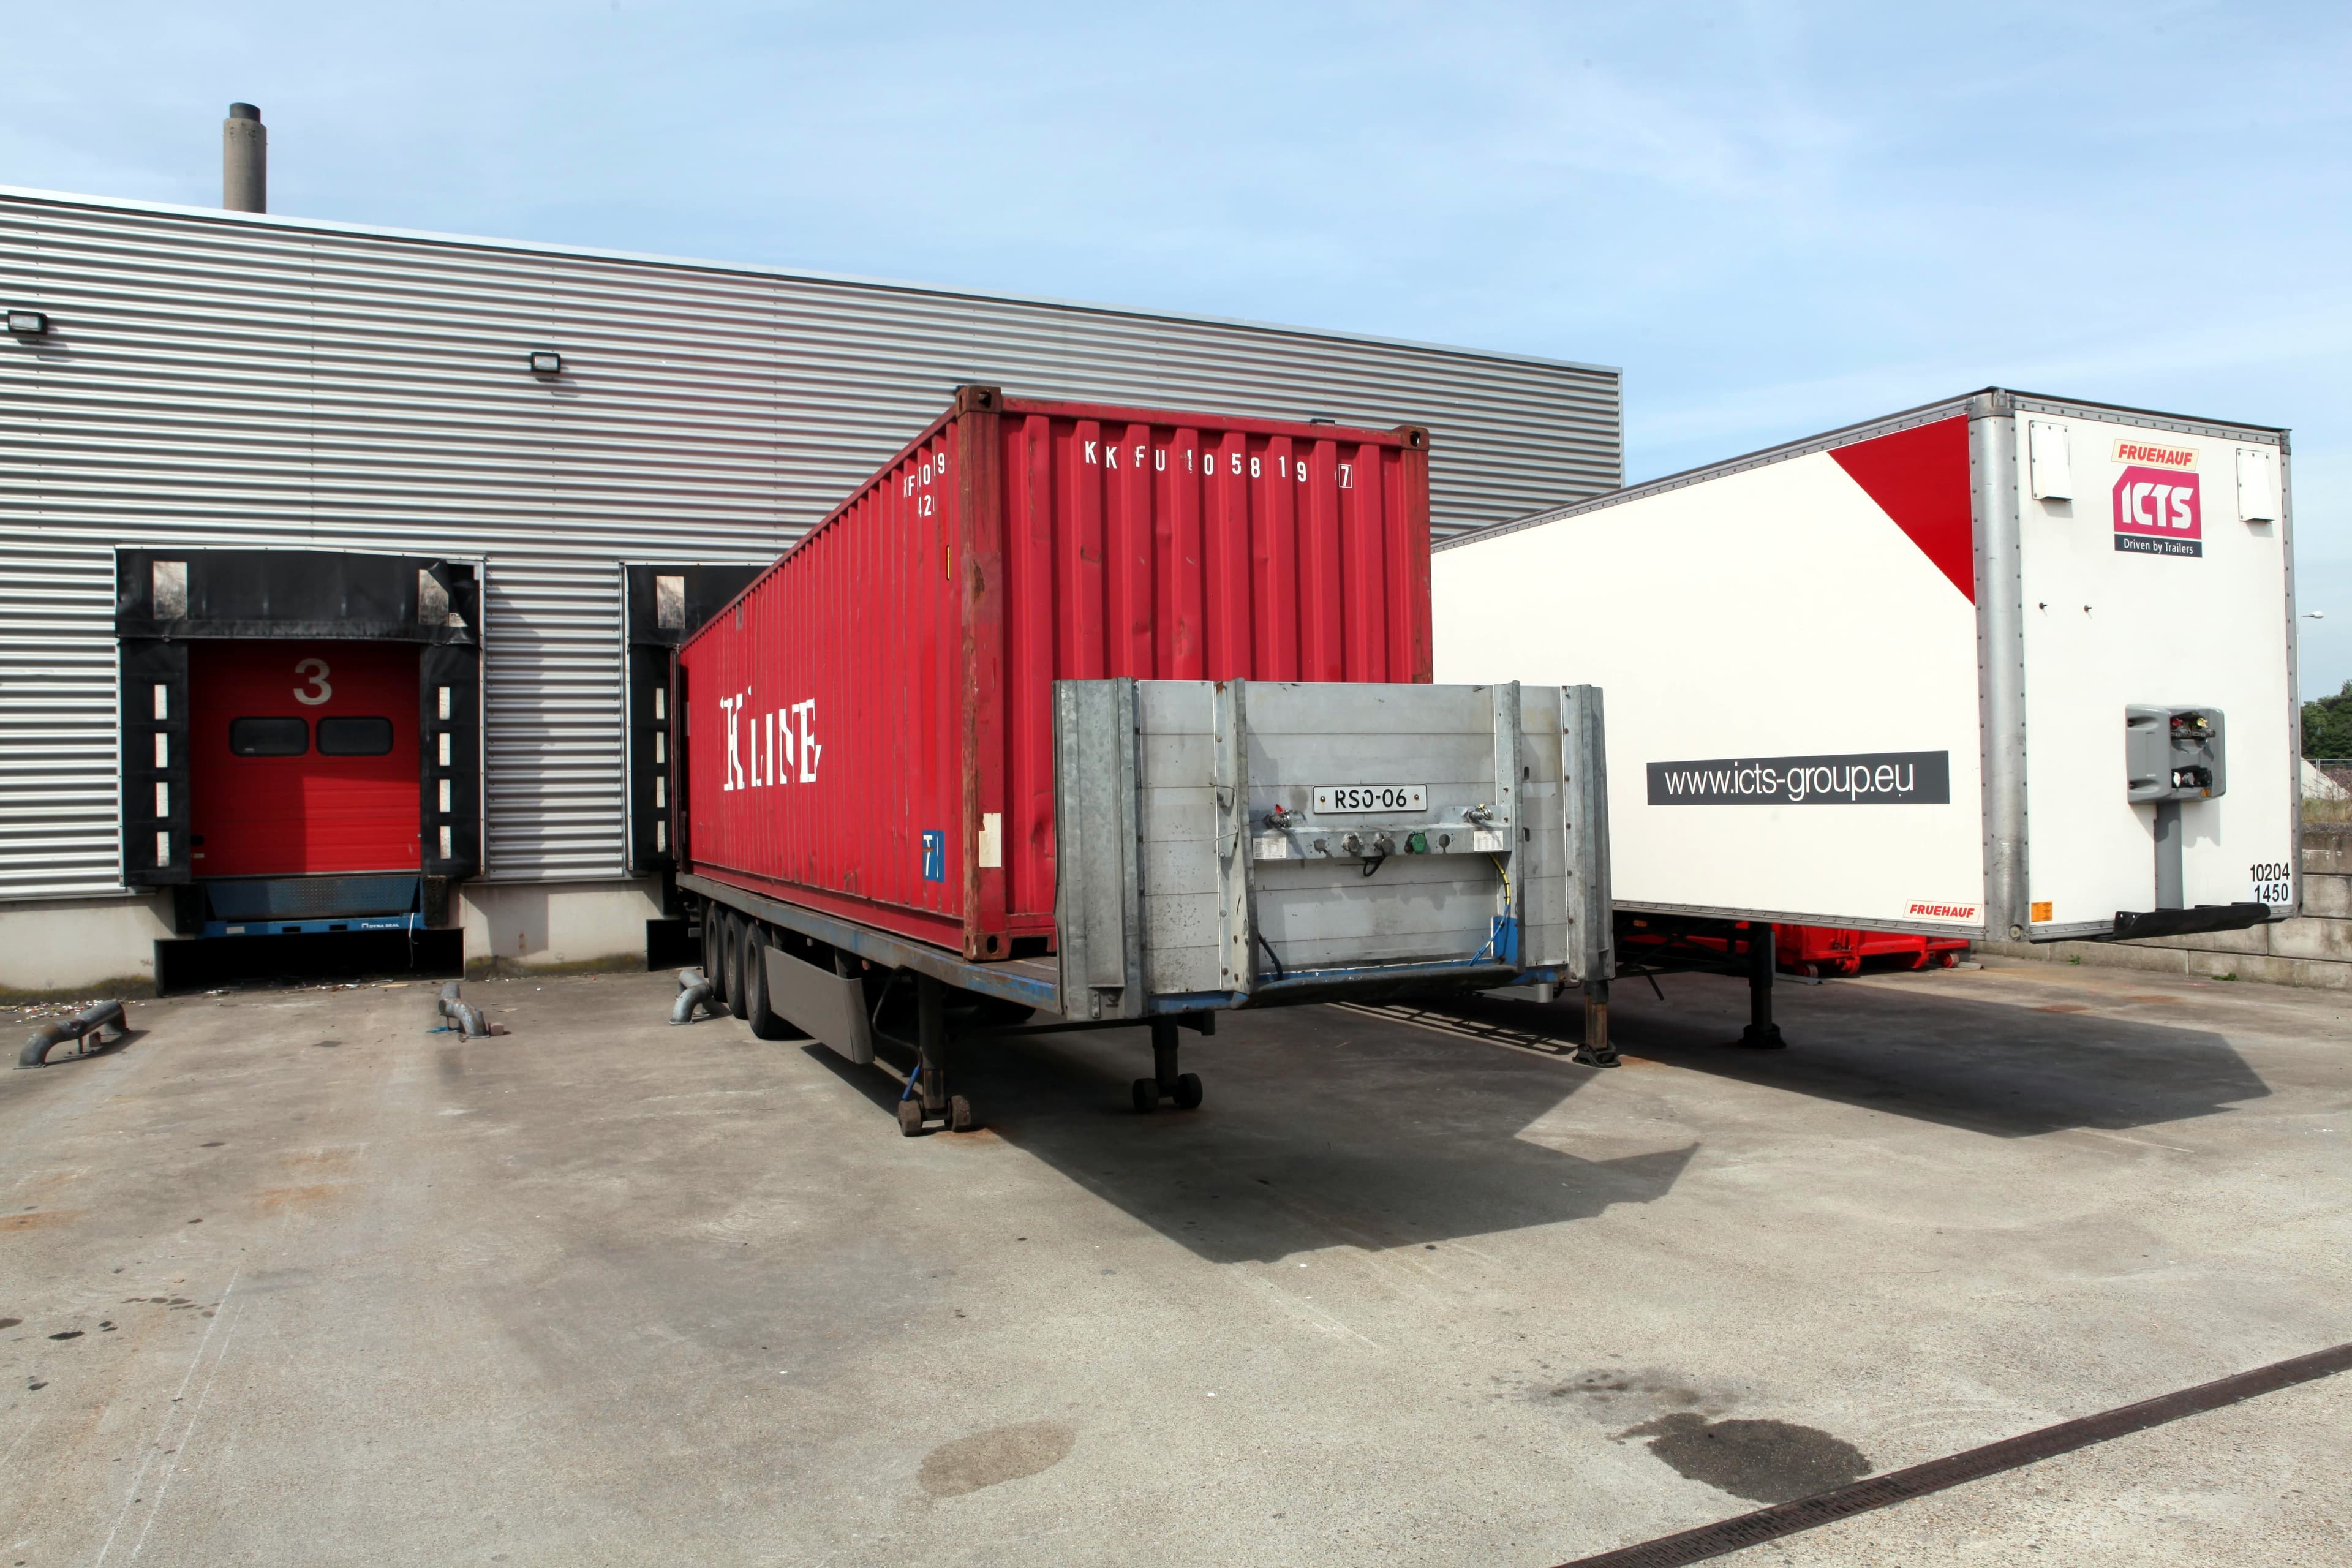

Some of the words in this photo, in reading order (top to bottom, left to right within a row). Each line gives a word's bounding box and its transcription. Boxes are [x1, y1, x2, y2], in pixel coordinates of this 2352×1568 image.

[2118, 444, 2192, 466] FRUEHAUF
[2121, 481, 2193, 529] ICTS
[2124, 538, 2150, 550] Driven
[2153, 540, 2162, 554] by
[2165, 542, 2193, 554] Trailers
[293, 658, 332, 706] 3
[1665, 761, 1914, 801] www.icts-group.eu
[2250, 862, 2290, 882] 10204
[2254, 883, 2288, 903] 1450
[1910, 904, 1975, 918] FRUEHAUF
